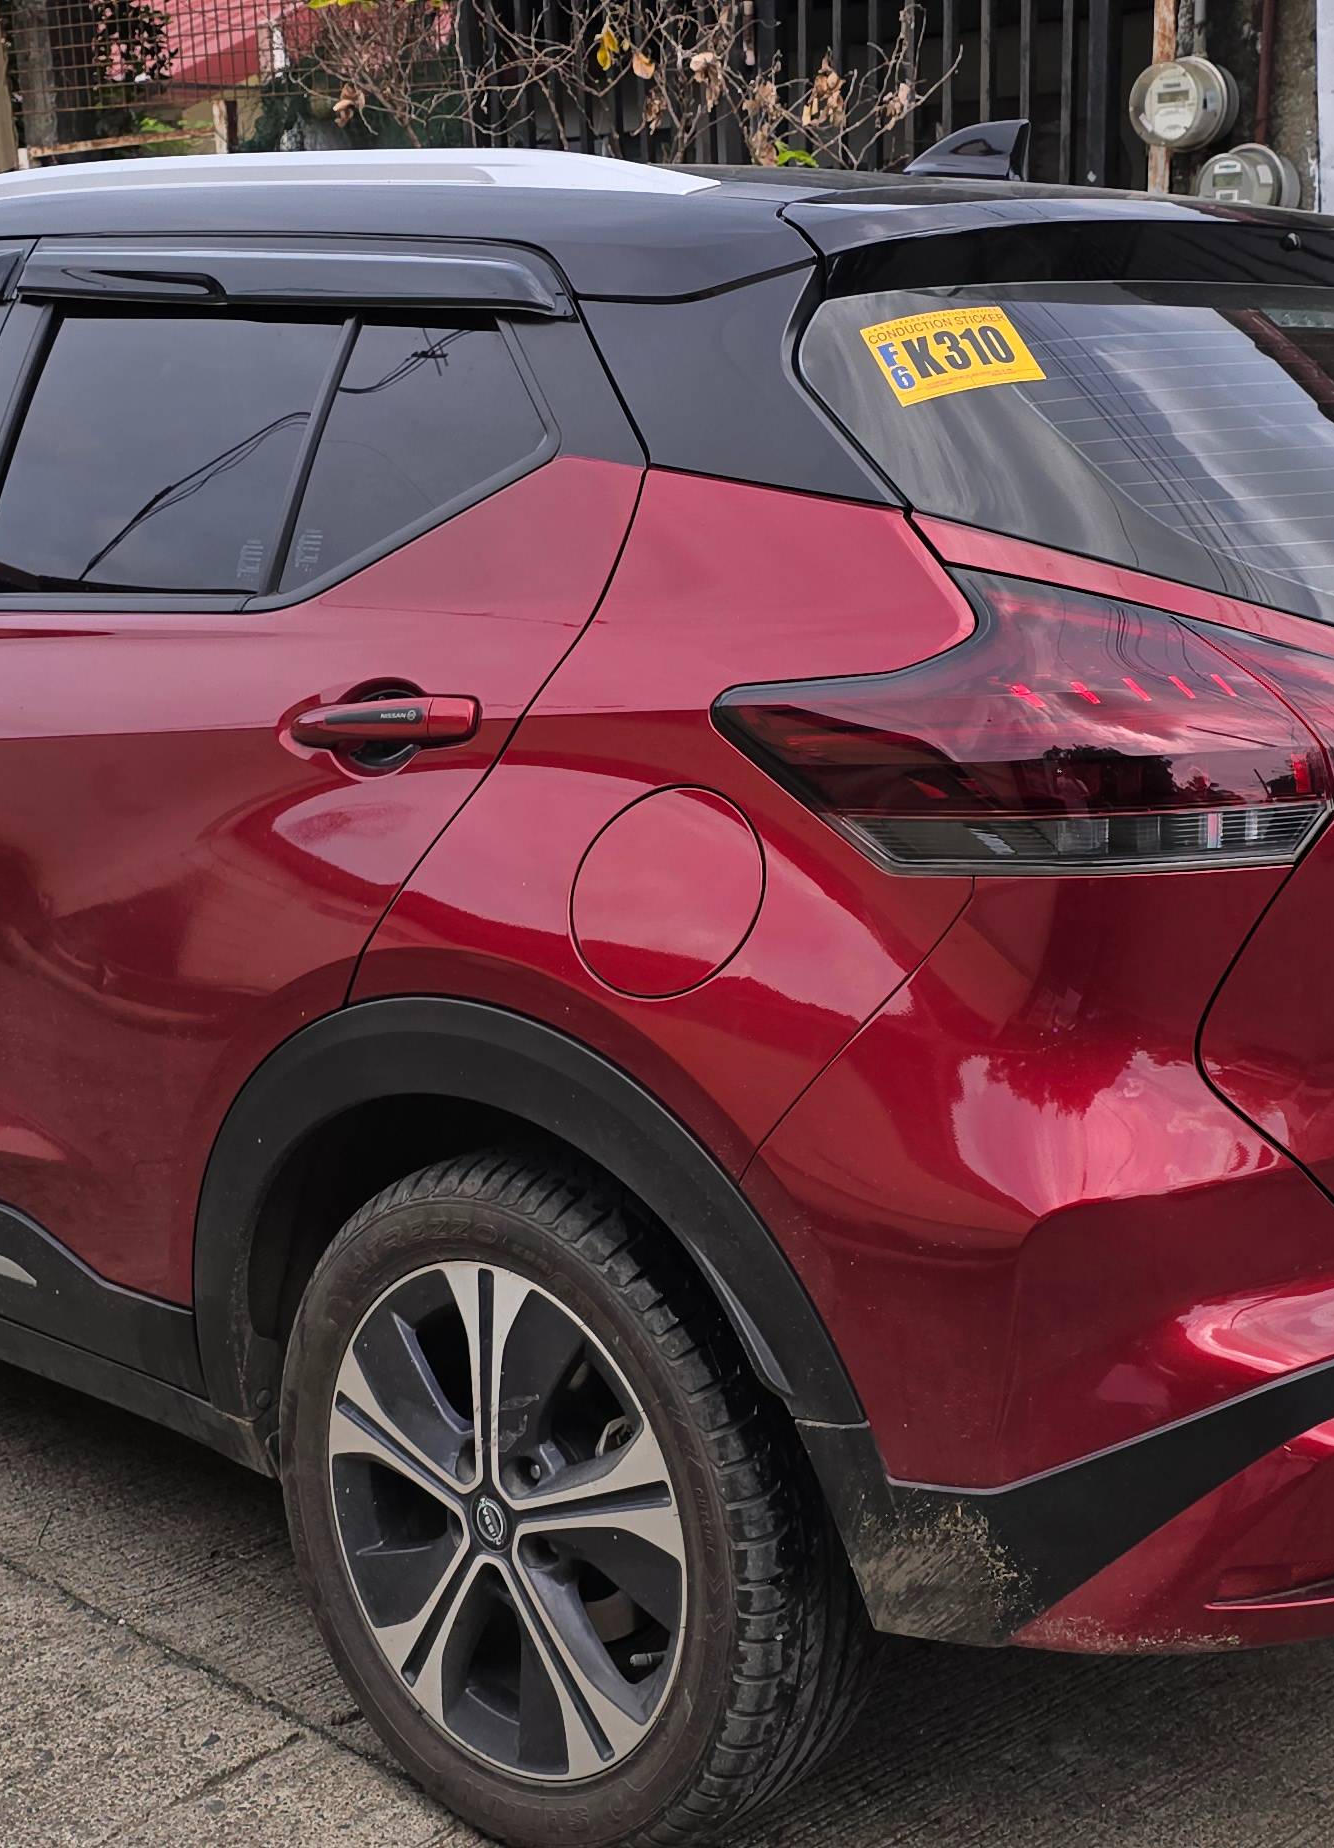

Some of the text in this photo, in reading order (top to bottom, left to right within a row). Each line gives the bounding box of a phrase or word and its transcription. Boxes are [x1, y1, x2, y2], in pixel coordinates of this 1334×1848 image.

[869, 313, 1005, 344] CONDUCTION STICKER
[877, 342, 899, 368] F
[902, 325, 1015, 379] K310
[891, 366, 916, 390] 6
